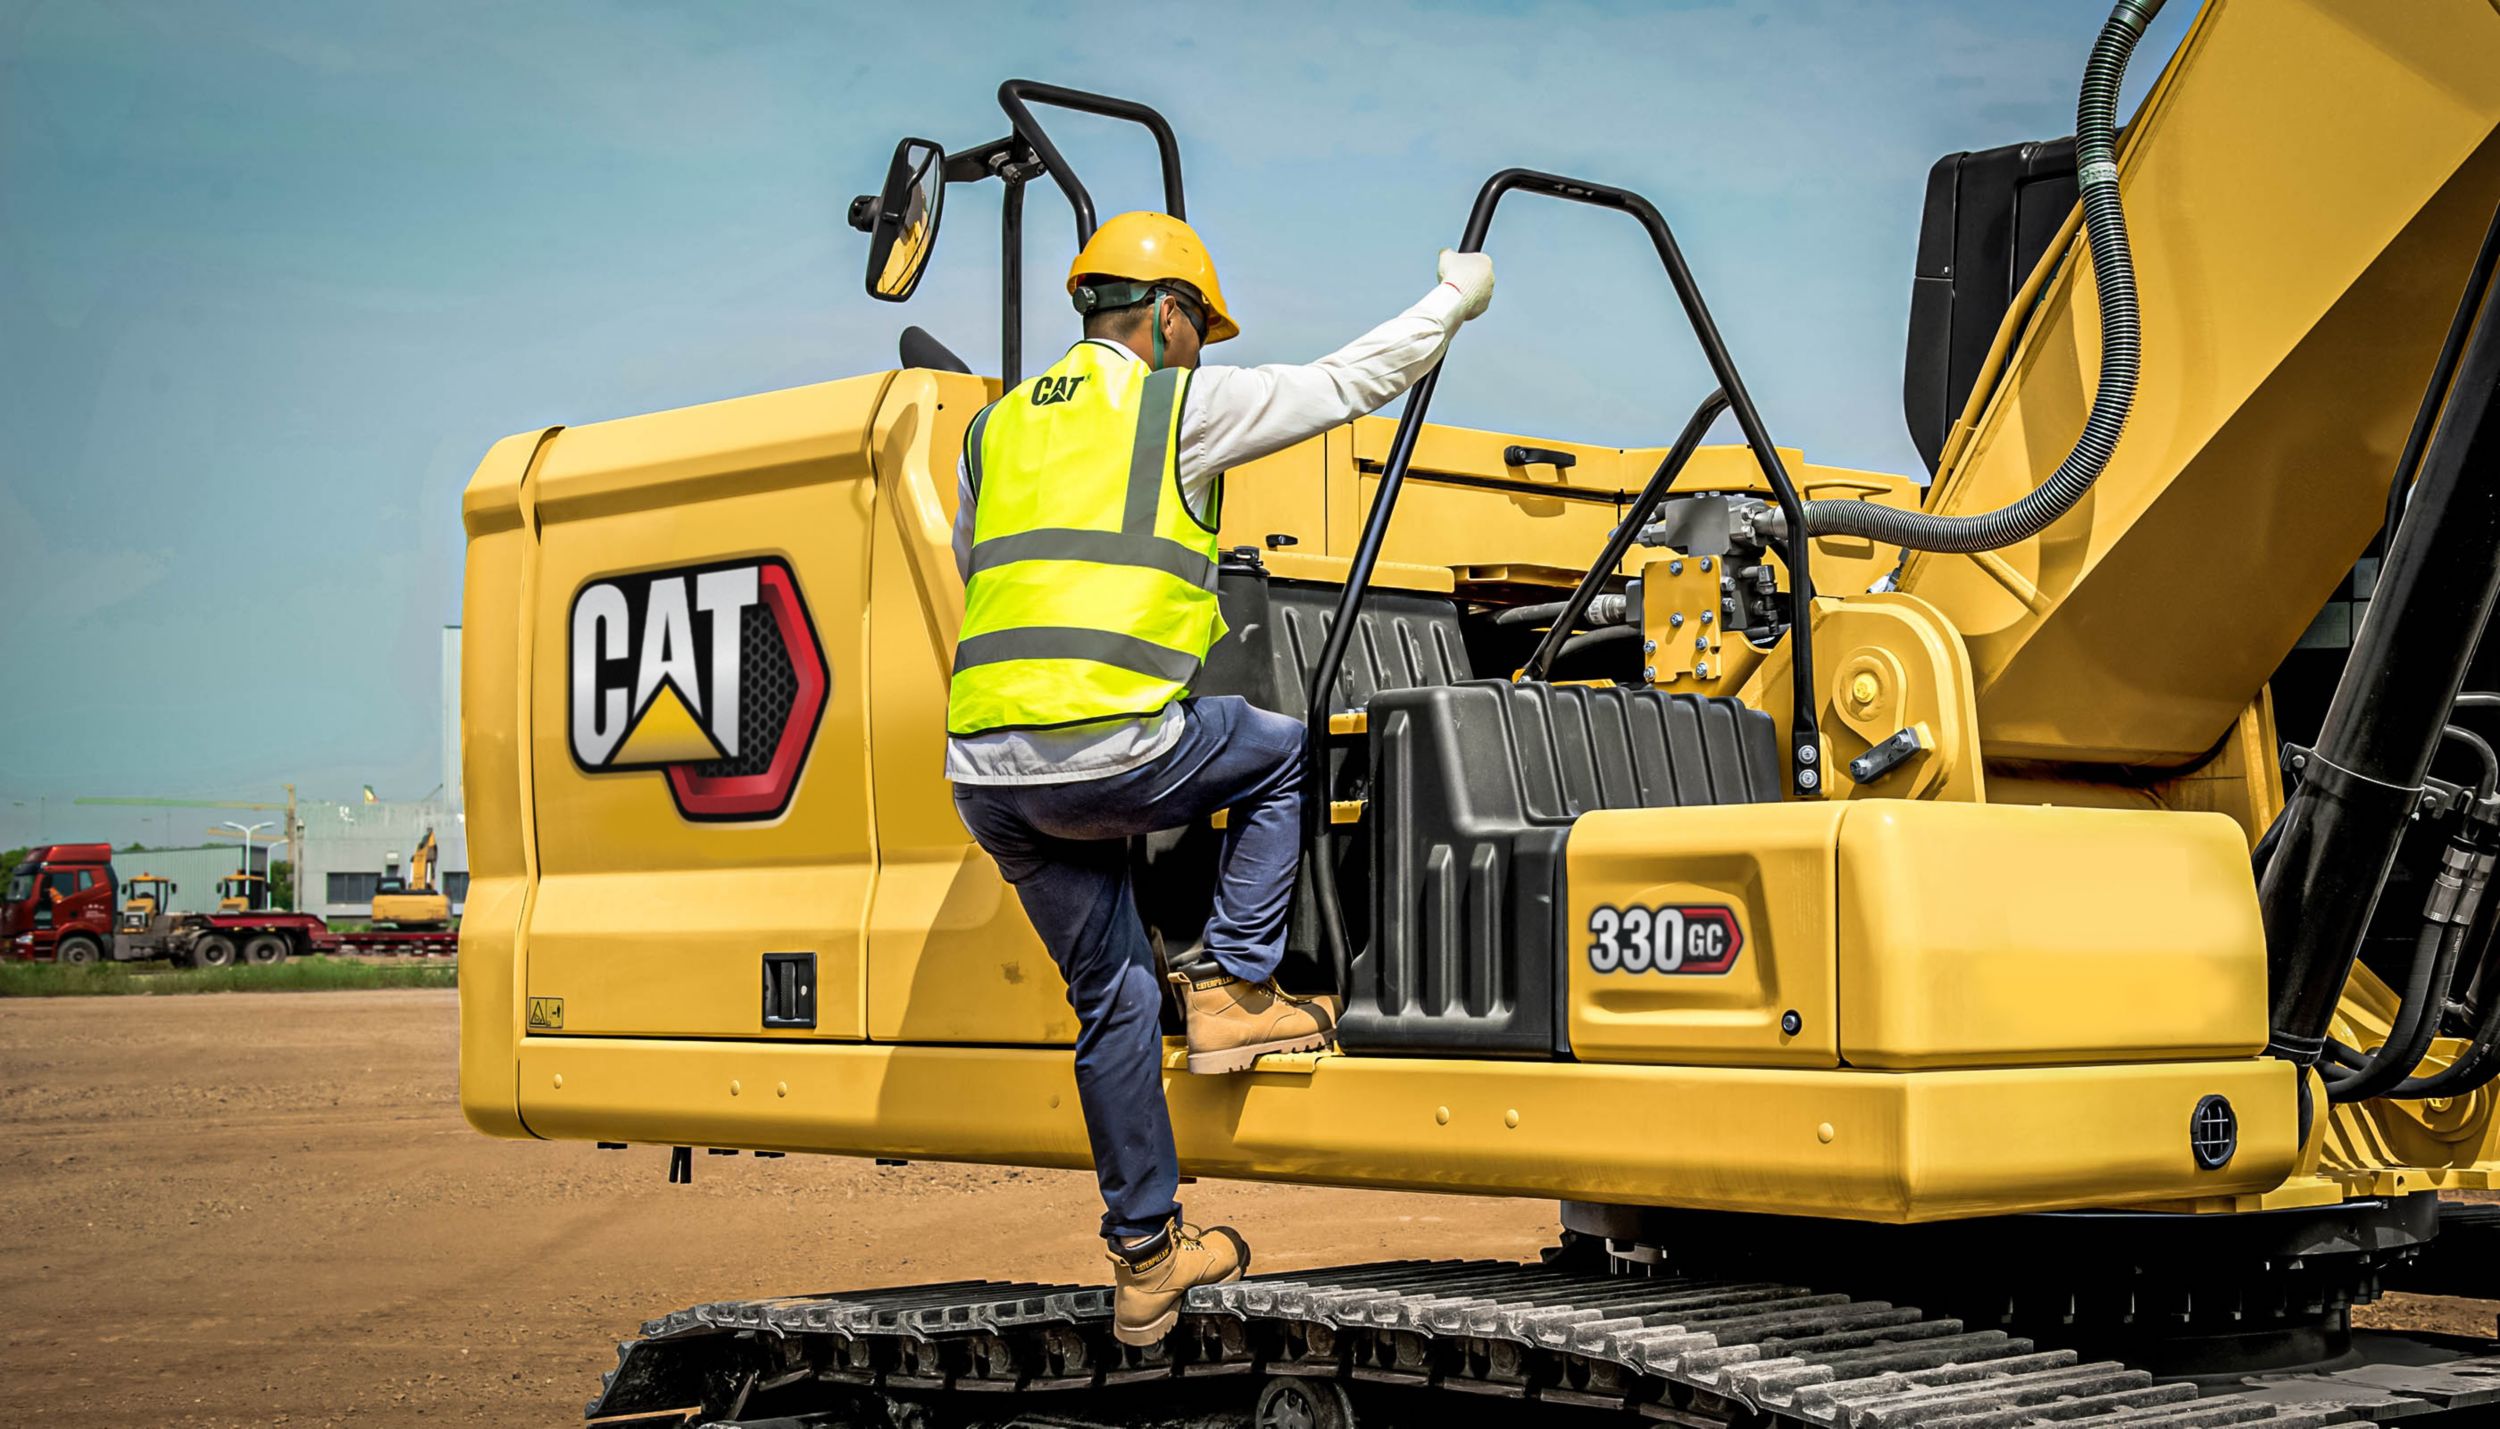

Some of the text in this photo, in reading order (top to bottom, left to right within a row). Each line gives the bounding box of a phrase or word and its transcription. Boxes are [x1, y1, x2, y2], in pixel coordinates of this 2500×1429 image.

[1031, 376, 1085, 406] CAT
[573, 566, 759, 765] CAT
[1591, 908, 1723, 971] 330 GC
